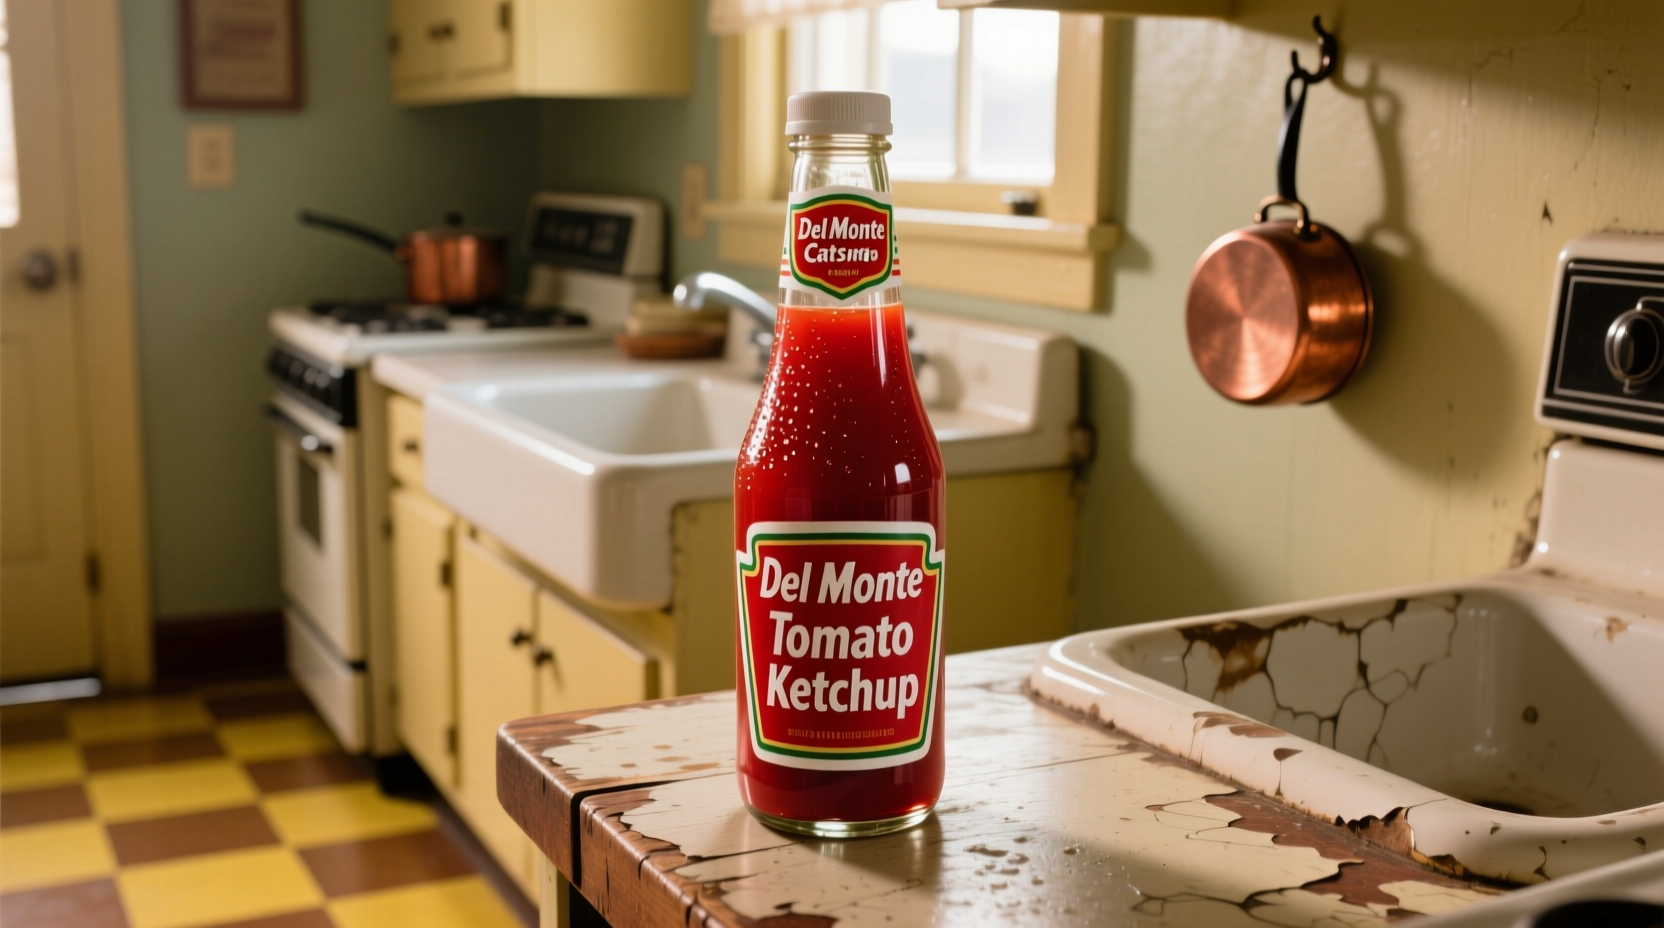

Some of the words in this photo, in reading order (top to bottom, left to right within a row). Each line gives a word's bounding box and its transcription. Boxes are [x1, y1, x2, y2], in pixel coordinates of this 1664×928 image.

[798, 217, 828, 240] Del
[828, 216, 885, 240] Monte
[760, 556, 812, 603] Del
[817, 561, 924, 604] Monte
[769, 610, 914, 660] Tomato
[766, 663, 919, 720] Ketchup
